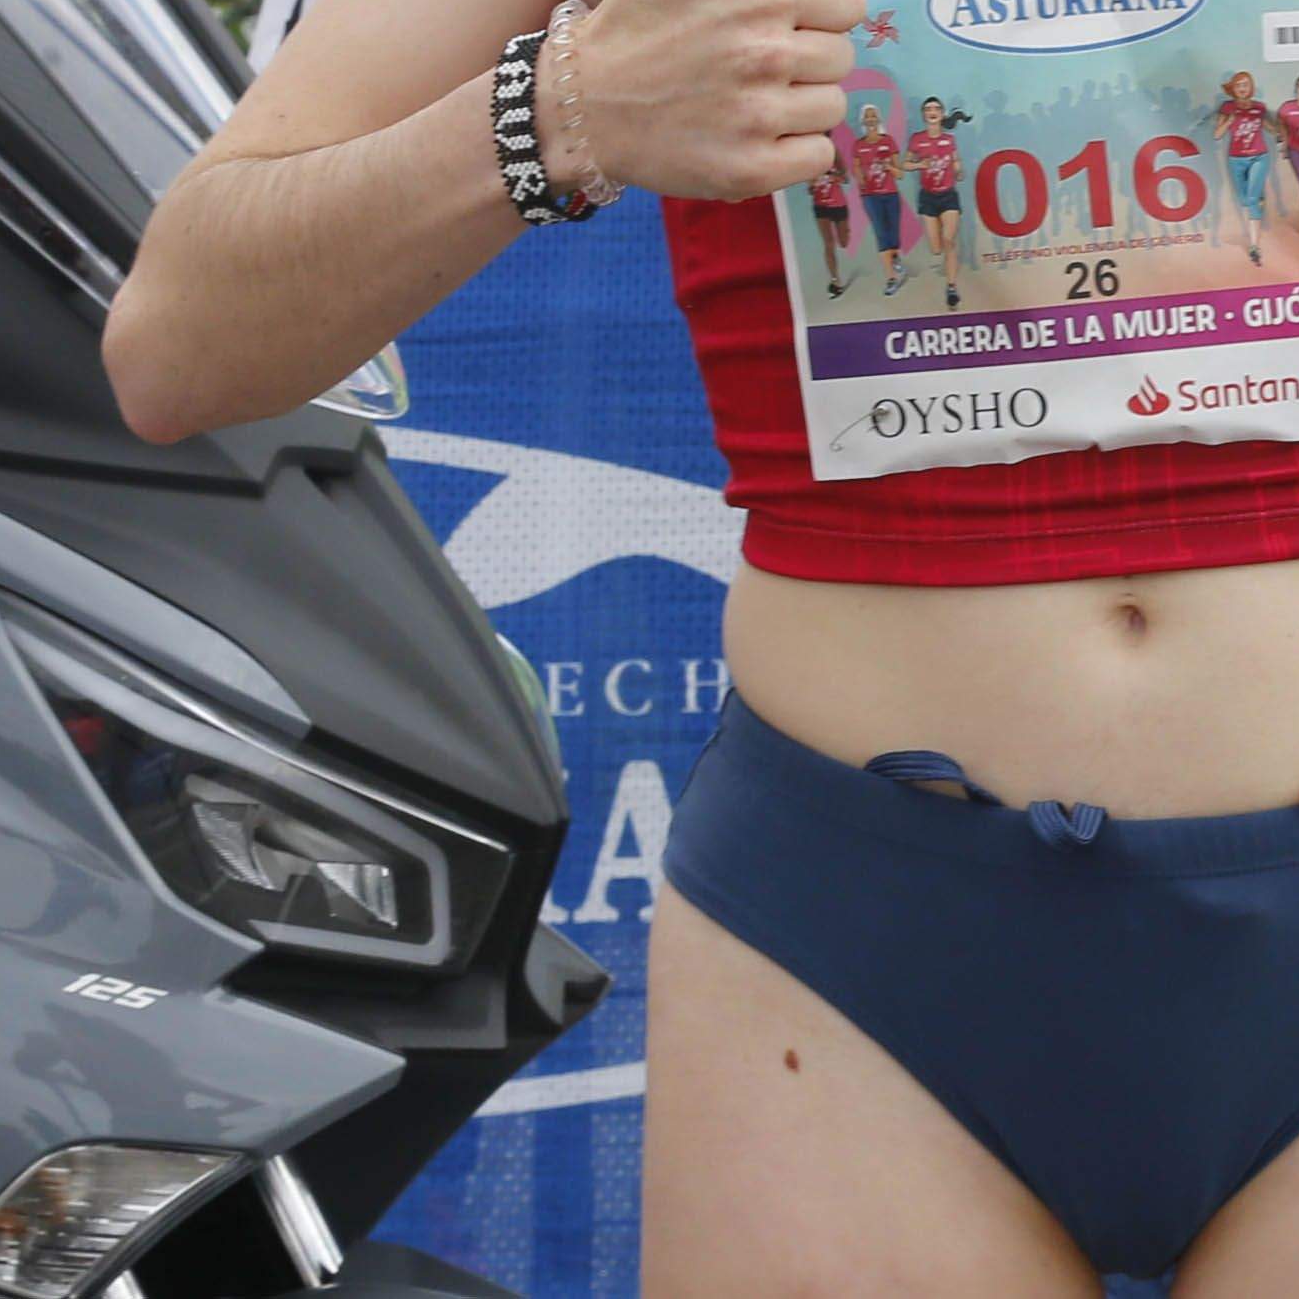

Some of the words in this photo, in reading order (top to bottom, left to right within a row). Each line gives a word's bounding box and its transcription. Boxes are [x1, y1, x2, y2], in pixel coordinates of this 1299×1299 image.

[974, 135, 1207, 238] 016
[1064, 258, 1120, 300] 26
[885, 325, 1012, 360] CARRERA
[1021, 319, 1058, 350] DE
[1065, 313, 1104, 344] LA
[1112, 304, 1216, 341] MUJER
[870, 387, 1048, 438] OYSHO
[62, 973, 168, 1010] 125
